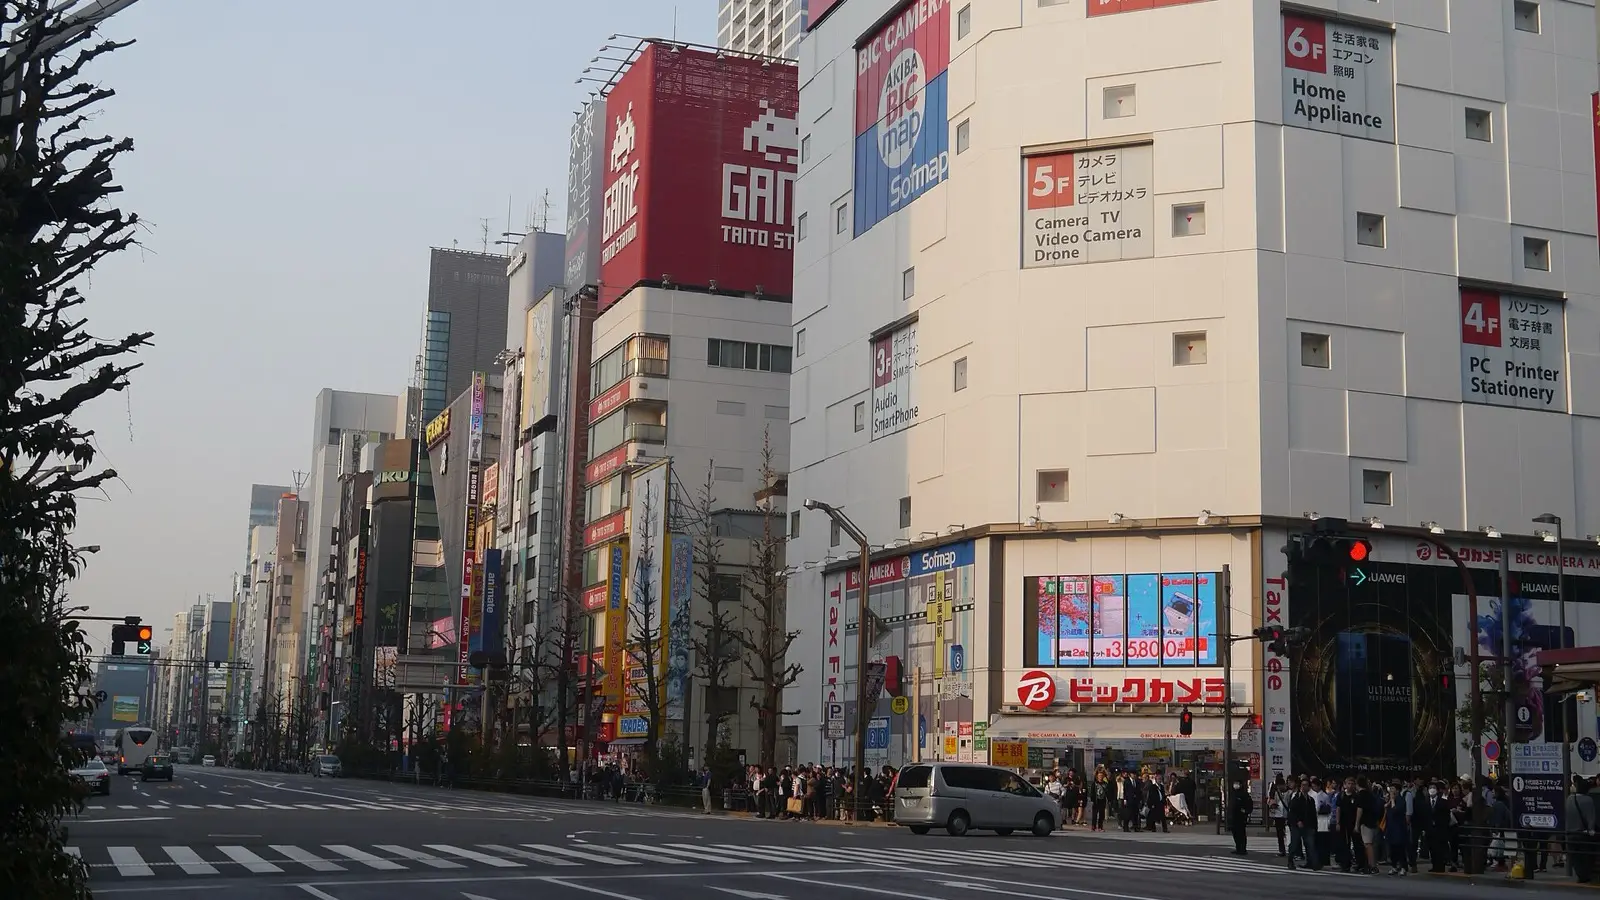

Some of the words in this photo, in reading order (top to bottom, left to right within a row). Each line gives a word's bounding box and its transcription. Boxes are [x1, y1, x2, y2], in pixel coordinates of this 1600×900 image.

[1287, 27, 1323, 59] 6F
[1332, 31, 1380, 50] 生活家電
[858, 33, 881, 76] BIC
[1332, 49, 1374, 65] エアコン
[885, 54, 918, 90] AKIBA
[1333, 64, 1355, 79] 照明
[886, 76, 919, 122] BIC
[1293, 78, 1346, 103] Home
[1294, 99, 1382, 129] Appliance
[881, 111, 920, 158] map
[1078, 153, 1117, 169] カメラ
[890, 151, 949, 207] Sofmap
[1032, 165, 1070, 197] 5F
[1078, 171, 1117, 187] テレビ
[603, 159, 640, 244] GAME
[721, 163, 796, 226] GAM
[1077, 187, 1147, 204] ビデオカメラ
[1035, 213, 1089, 231] Camera
[1100, 211, 1120, 225] TV
[721, 225, 768, 248] TAITO
[1035, 229, 1079, 247] Video
[1083, 226, 1142, 244] Camera
[1034, 247, 1079, 262] Drone
[1464, 303, 1498, 334] 4F
[1508, 300, 1550, 316] パソコン
[1508, 318, 1553, 335] 電子辞書
[1509, 335, 1541, 351] 文房具
[876, 348, 892, 378] 3F
[1470, 357, 1491, 375] PC
[1505, 361, 1559, 382] Printer
[1471, 377, 1554, 404] Stationery
[874, 392, 898, 414] Audio
[874, 404, 919, 435] SmartPhone
[922, 551, 956, 571] Sofmap
[1515, 552, 1534, 565] BIC
[868, 563, 895, 582] AMERA
[1367, 572, 1406, 584] UAWEI
[487, 572, 496, 614] animate
[1266, 577, 1286, 623] Tax
[829, 582, 841, 648] Tax
[828, 656, 840, 702] Fre
[1070, 678, 1225, 703] ビックカメラ
[1368, 685, 1411, 695] ULTIMATE
[830, 704, 842, 719] P
[996, 743, 1025, 757] 半額
